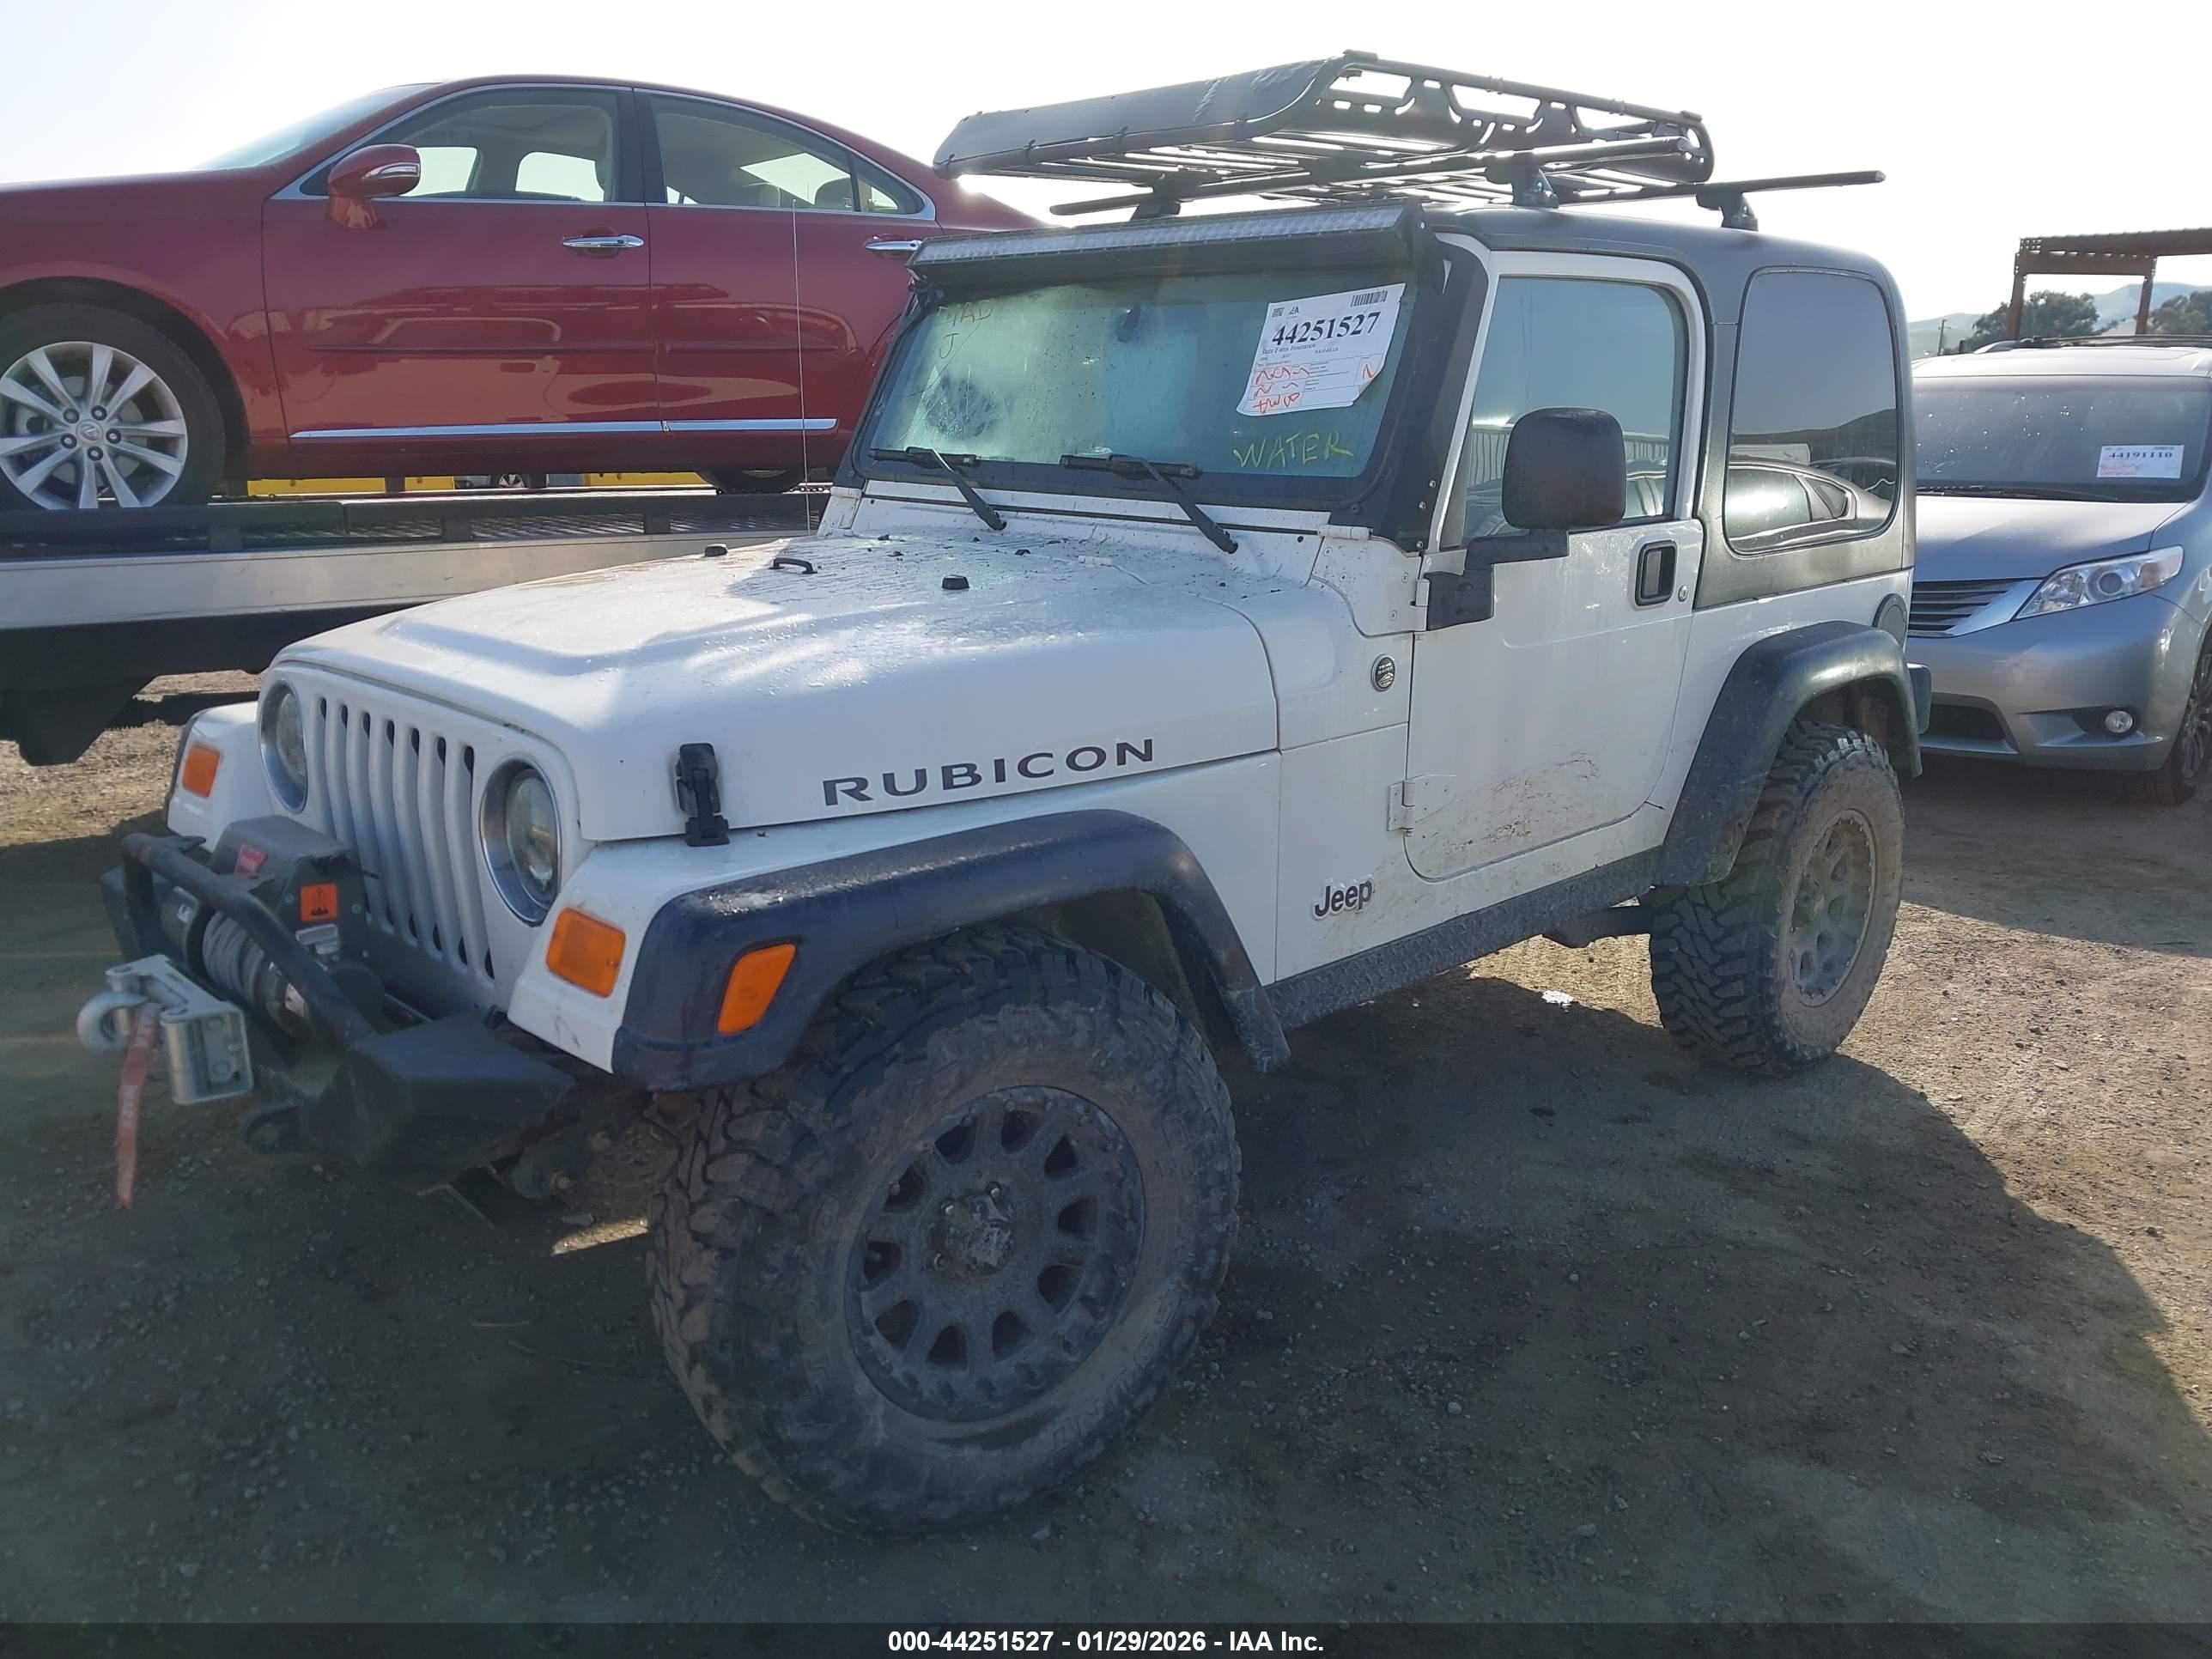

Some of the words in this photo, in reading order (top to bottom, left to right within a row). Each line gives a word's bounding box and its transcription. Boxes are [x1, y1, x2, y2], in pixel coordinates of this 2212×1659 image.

[1272, 312, 1381, 345] 44251527
[1233, 429, 1354, 469] WATER
[823, 738, 1153, 806] RUBICON
[1314, 880, 1373, 917] Jeep
